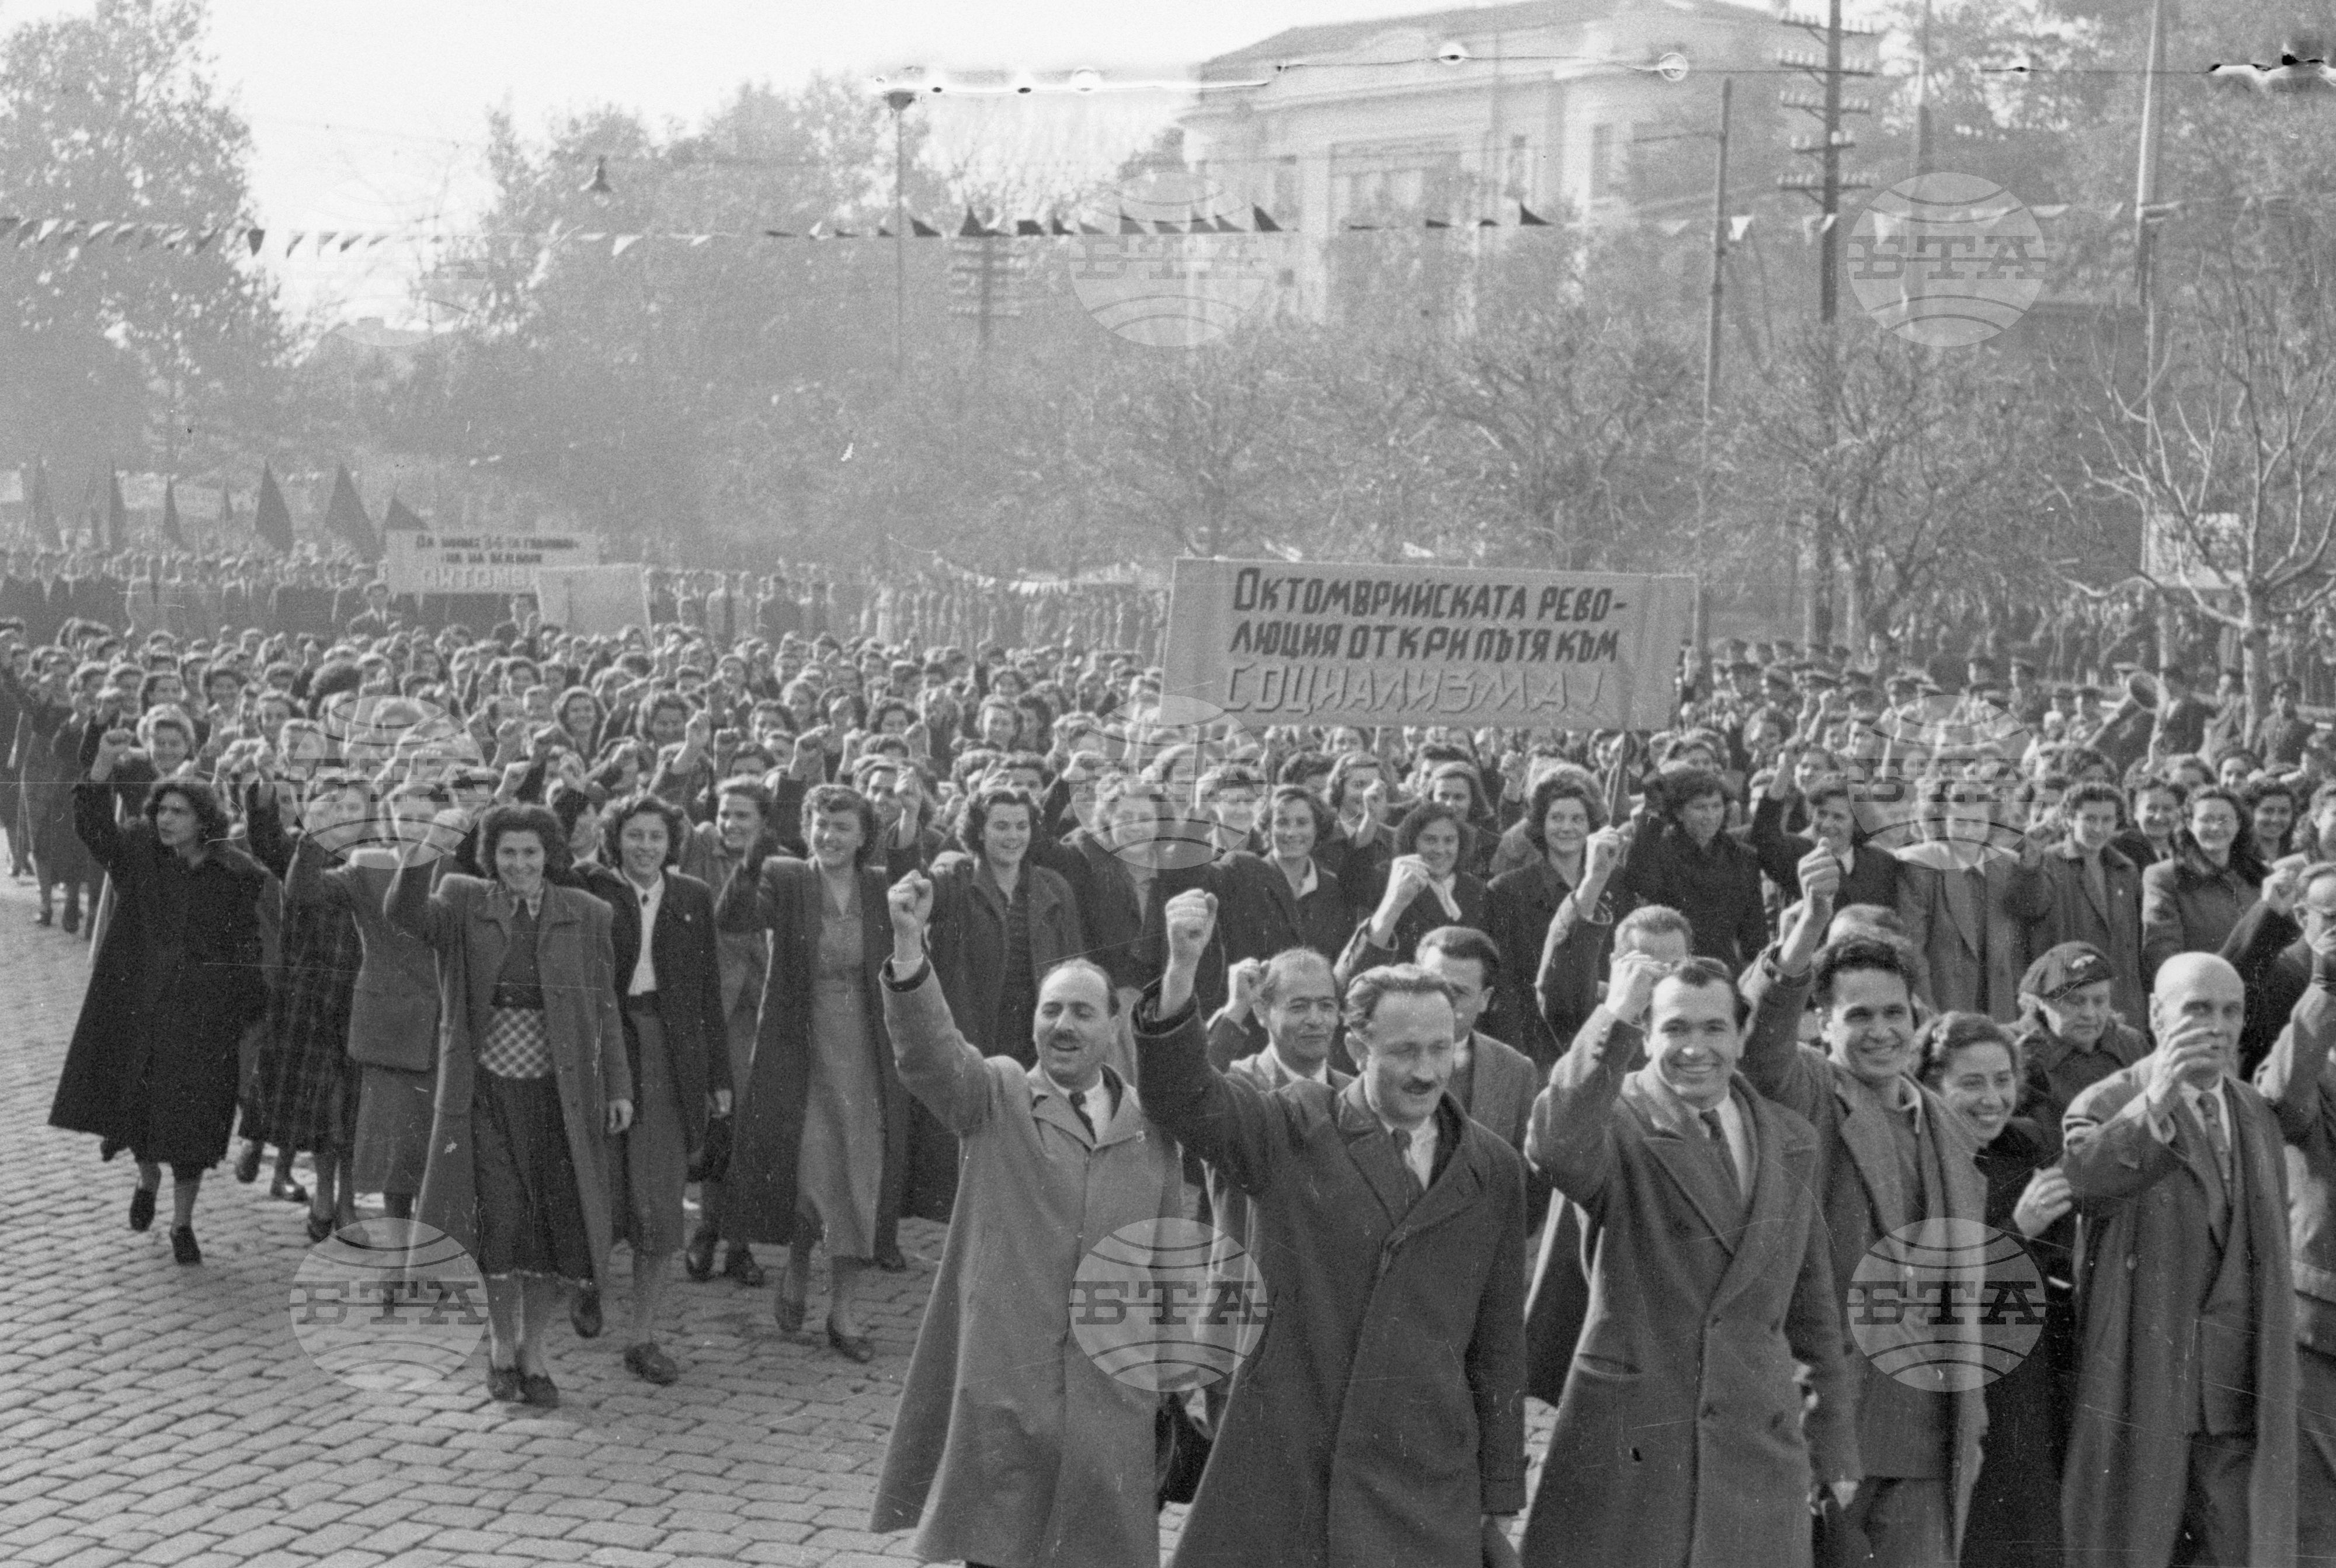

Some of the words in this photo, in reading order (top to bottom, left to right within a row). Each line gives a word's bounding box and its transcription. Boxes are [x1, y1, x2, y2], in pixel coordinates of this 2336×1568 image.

[1233, 567, 1526, 621] ОКТОМВРИЙСКАТА
[1537, 586, 1627, 622] РЕВО-
[1229, 620, 1343, 658] ЛЮЦИЯ
[1347, 624, 1471, 662] ОТКРИ
[1473, 628, 1551, 663] ПЪТЯ
[1555, 630, 1619, 663] КЪМ
